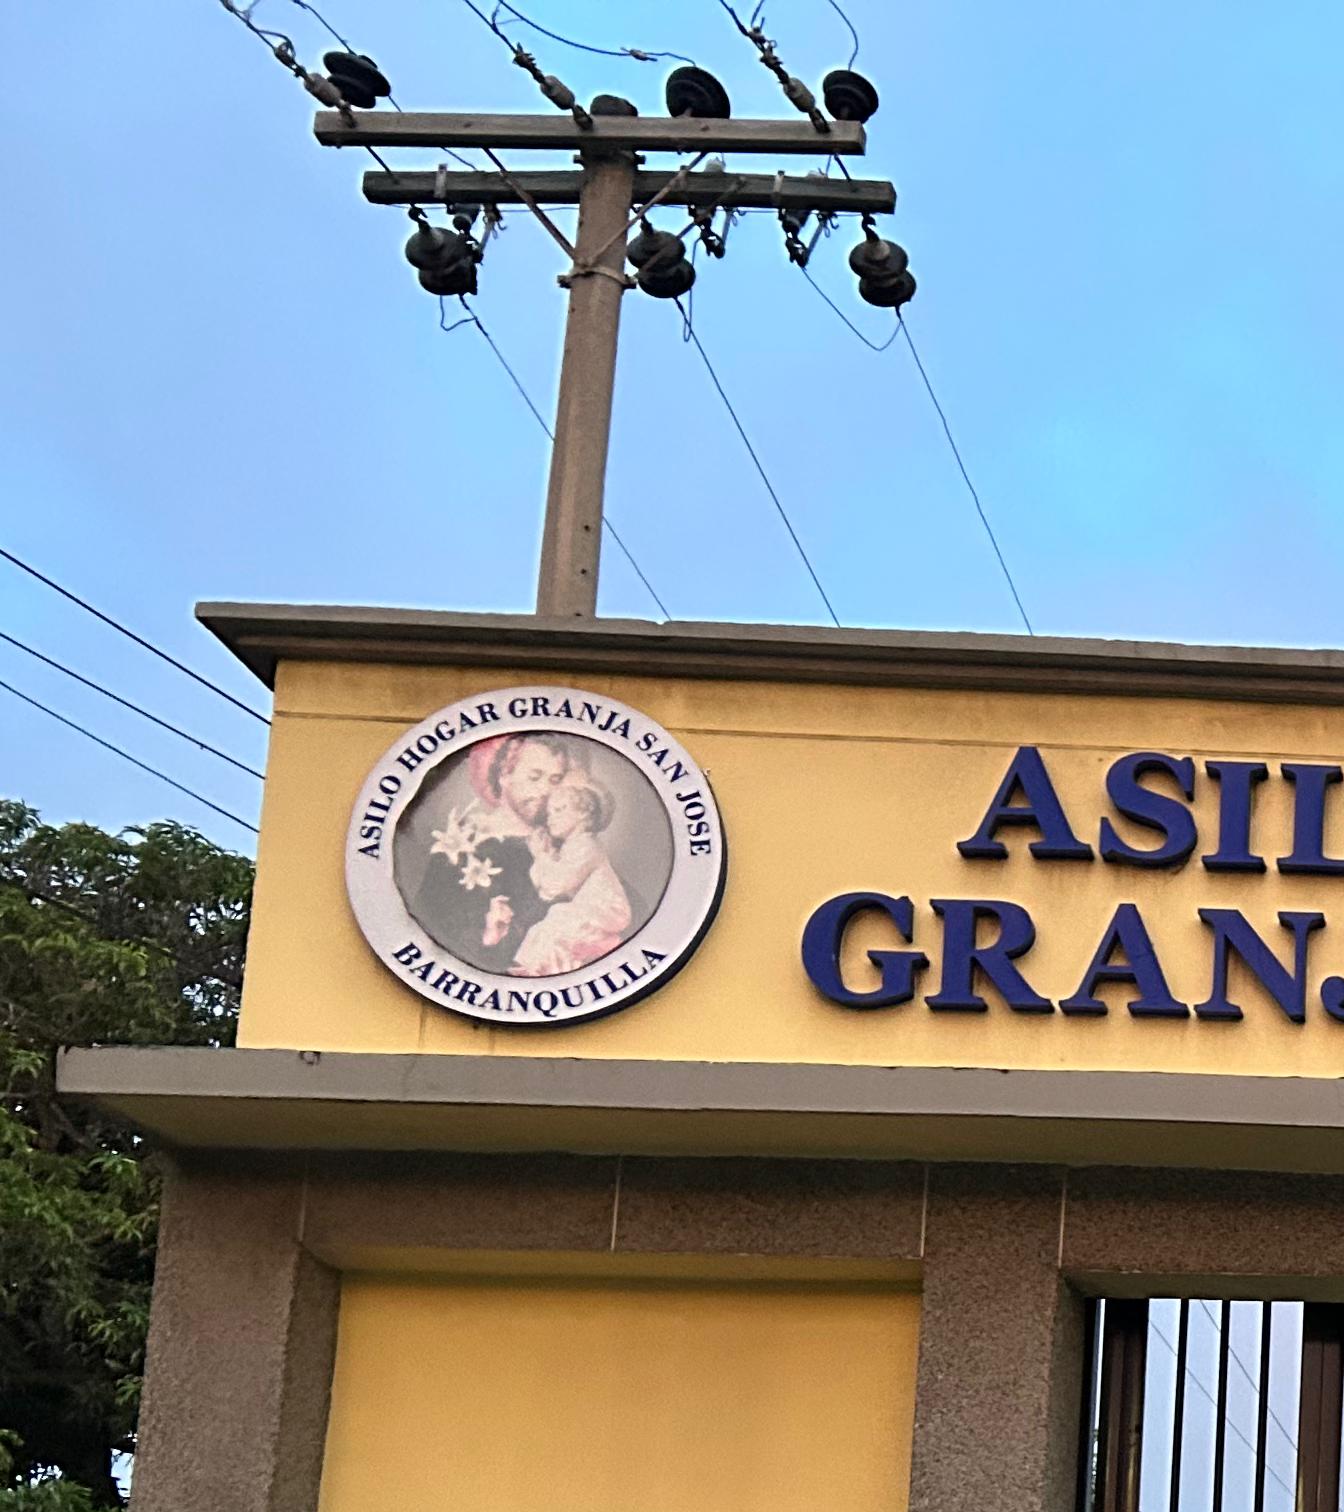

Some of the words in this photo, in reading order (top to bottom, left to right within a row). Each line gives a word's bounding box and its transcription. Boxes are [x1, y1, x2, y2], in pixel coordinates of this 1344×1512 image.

[357, 774, 403, 859] ASILO
[395, 702, 501, 772] HOGAR
[509, 697, 631, 740] GRANJA
[635, 732, 689, 784] SAN
[675, 790, 712, 856] JOSE
[391, 942, 669, 1018] BARRANQUILLA
